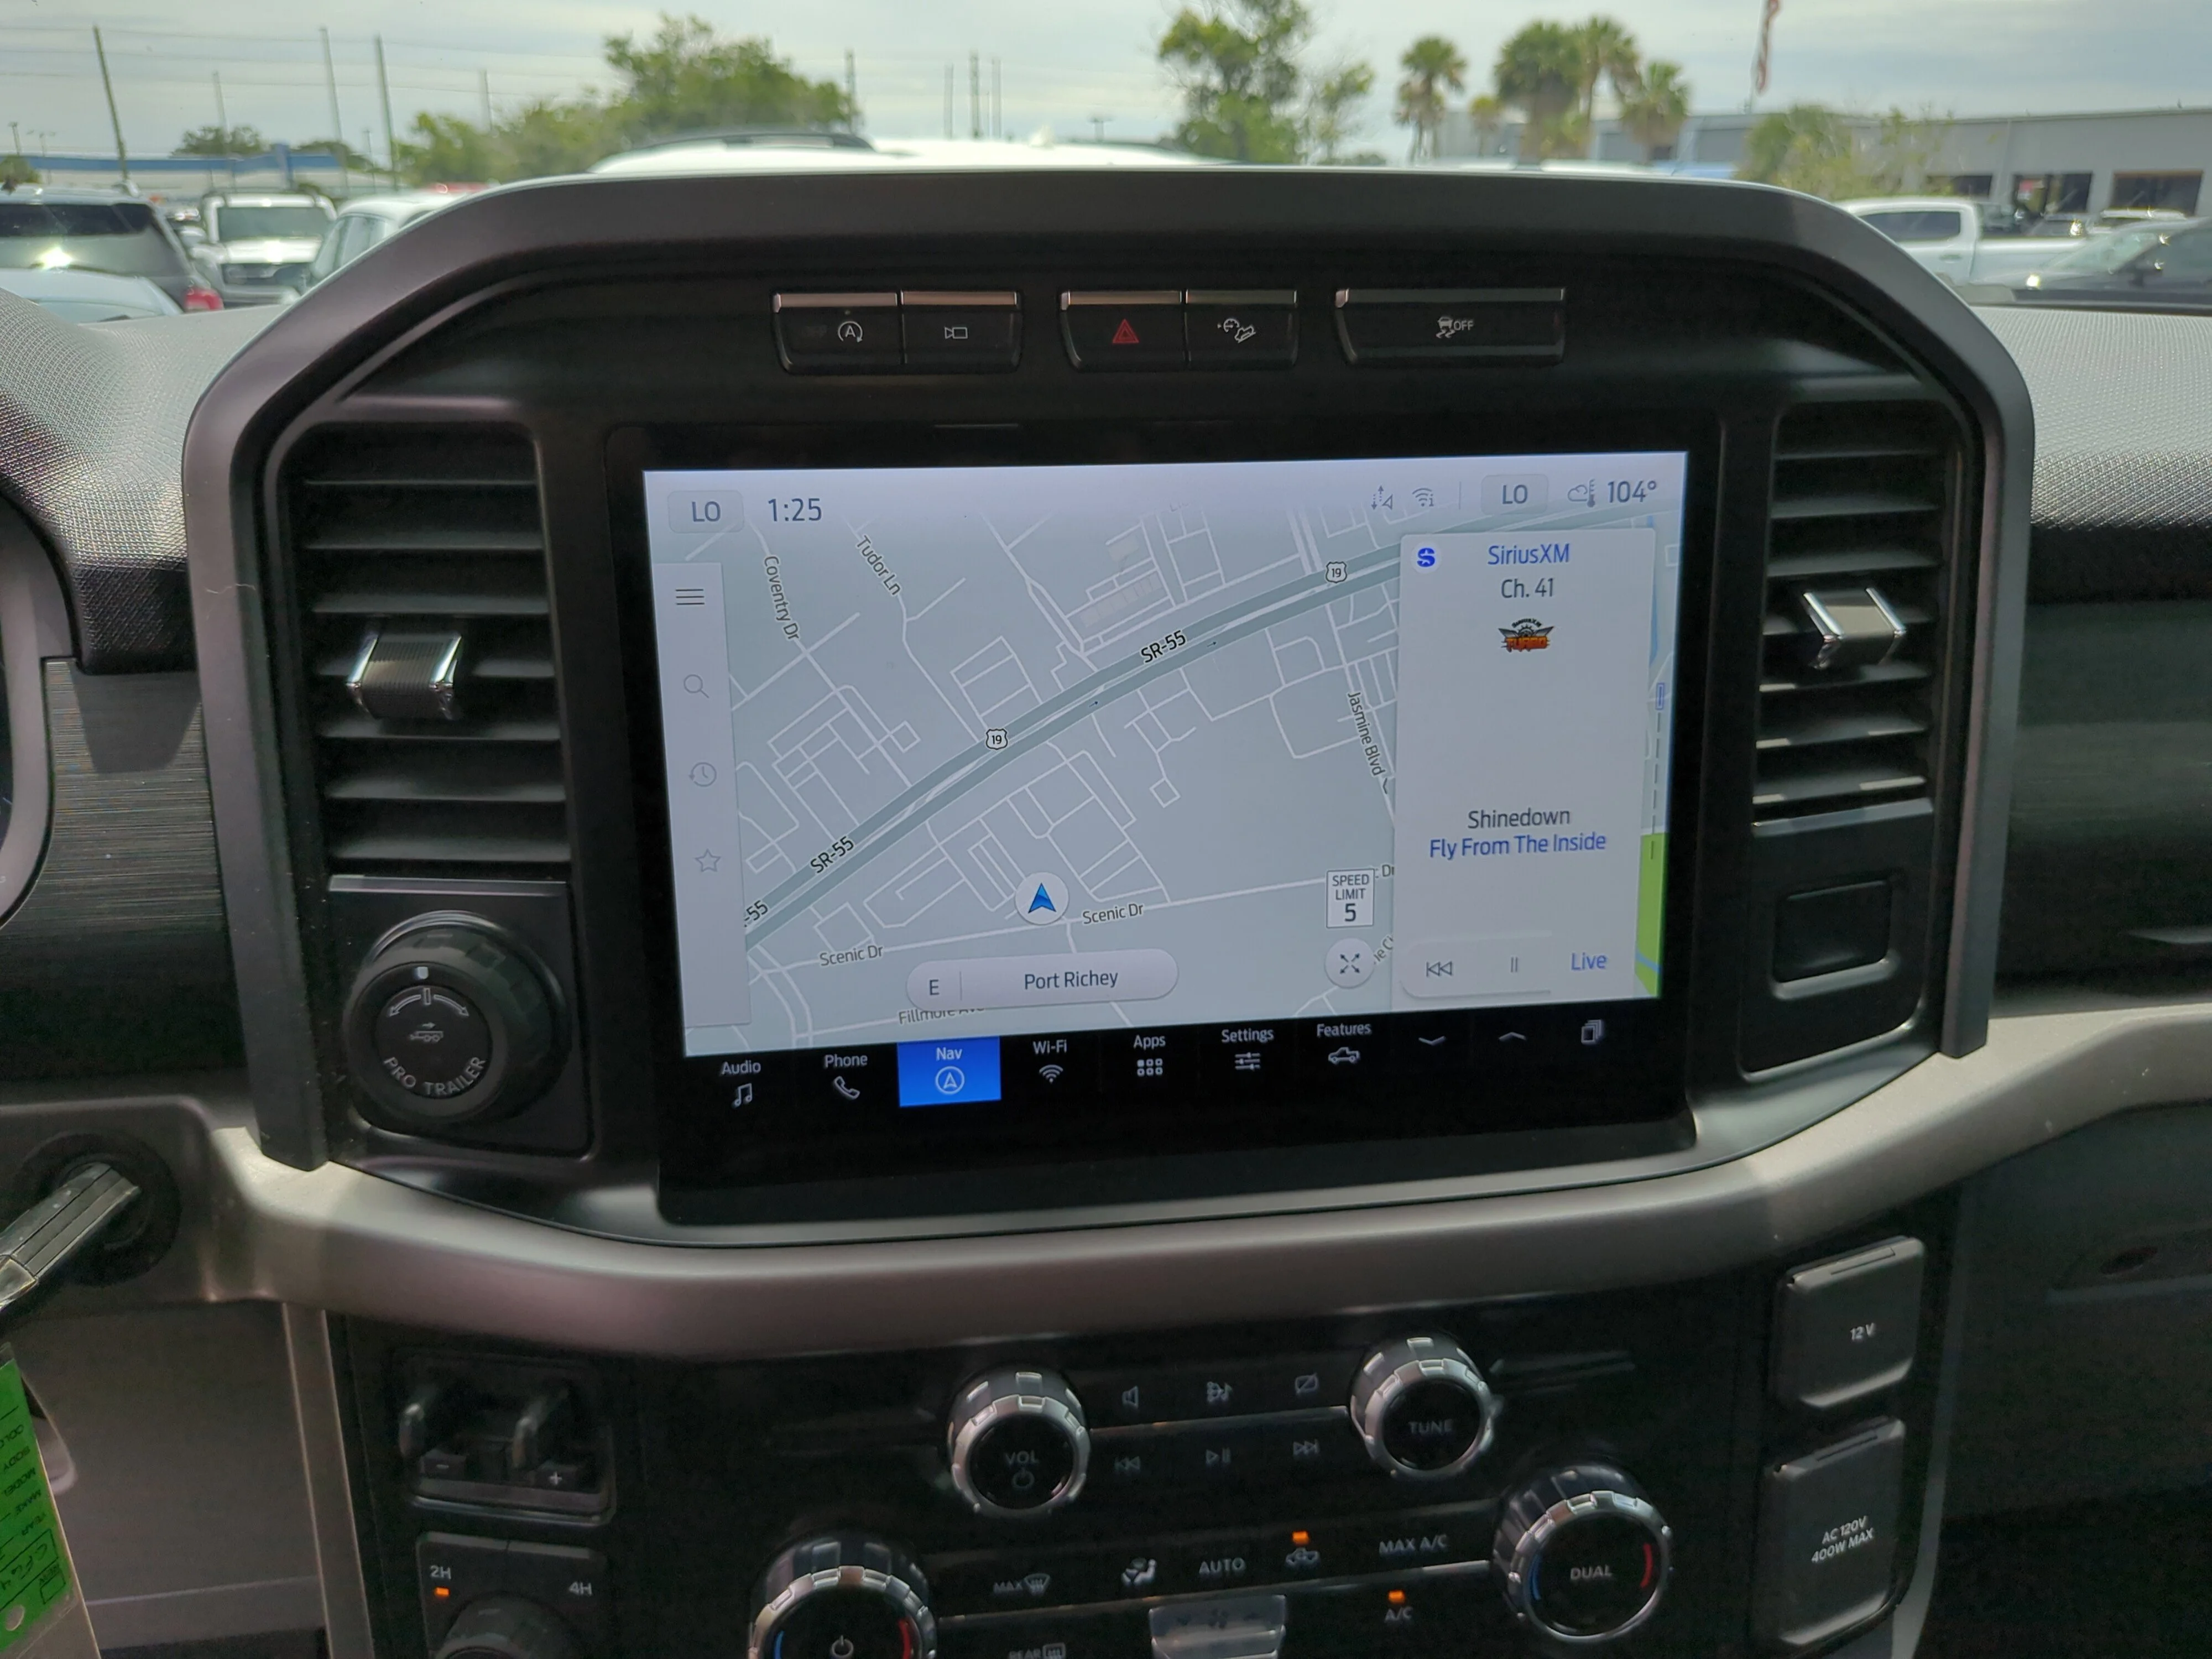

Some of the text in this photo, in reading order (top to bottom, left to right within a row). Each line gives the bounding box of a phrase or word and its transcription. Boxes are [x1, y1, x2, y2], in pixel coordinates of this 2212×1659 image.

[1453, 319, 1474, 331] OFF
[1502, 484, 1528, 505] LO
[1607, 479, 1657, 504] 104°
[691, 500, 721, 523] LO
[768, 498, 823, 523] 1:25
[1487, 542, 1571, 565] SiriusXM
[856, 535, 901, 596] Tudor Ln
[1331, 567, 1342, 578] 19
[1501, 577, 1555, 598] Ch. 41
[764, 555, 799, 640] Coventry Dr
[1140, 630, 1187, 664] SR-55
[992, 734, 1002, 745] 19
[1348, 692, 1386, 776] Jasmine Blvd
[1467, 807, 1571, 830] Shinedown
[810, 836, 855, 874] SR-55
[1429, 831, 1607, 861] Fly From The Inside
[1332, 874, 1370, 886] SPEED
[1335, 888, 1366, 900] LIMIT
[1082, 904, 1144, 925] Scenic Dr
[1344, 902, 1357, 922] 5
[819, 944, 884, 967] Scenic Dr
[1571, 952, 1608, 971] Live
[929, 979, 940, 995] E
[1024, 969, 1119, 991] Port Richey
[1221, 1027, 1275, 1044] Settings
[1316, 1022, 1372, 1037] Features
[1032, 1040, 1068, 1055] Wi-Fi
[1133, 1034, 1166, 1050] Apps
[824, 1053, 868, 1068] Phone
[935, 1046, 963, 1061] Nav
[384, 1056, 486, 1095] PRO TRAILER
[721, 1060, 761, 1075] Audio
[1409, 1420, 1454, 1435] TUNE
[1004, 1449, 1039, 1465] VOL
[1822, 1515, 1867, 1545] AC 120V
[1379, 1534, 1448, 1554] MAX A/C
[1811, 1527, 1874, 1563] 400W MAX
[429, 1564, 452, 1580] 2H
[1199, 1557, 1246, 1574] AUTO
[1569, 1564, 1613, 1581] DUAL
[568, 1582, 592, 1596] 4H
[1384, 1606, 1413, 1621] A/C
